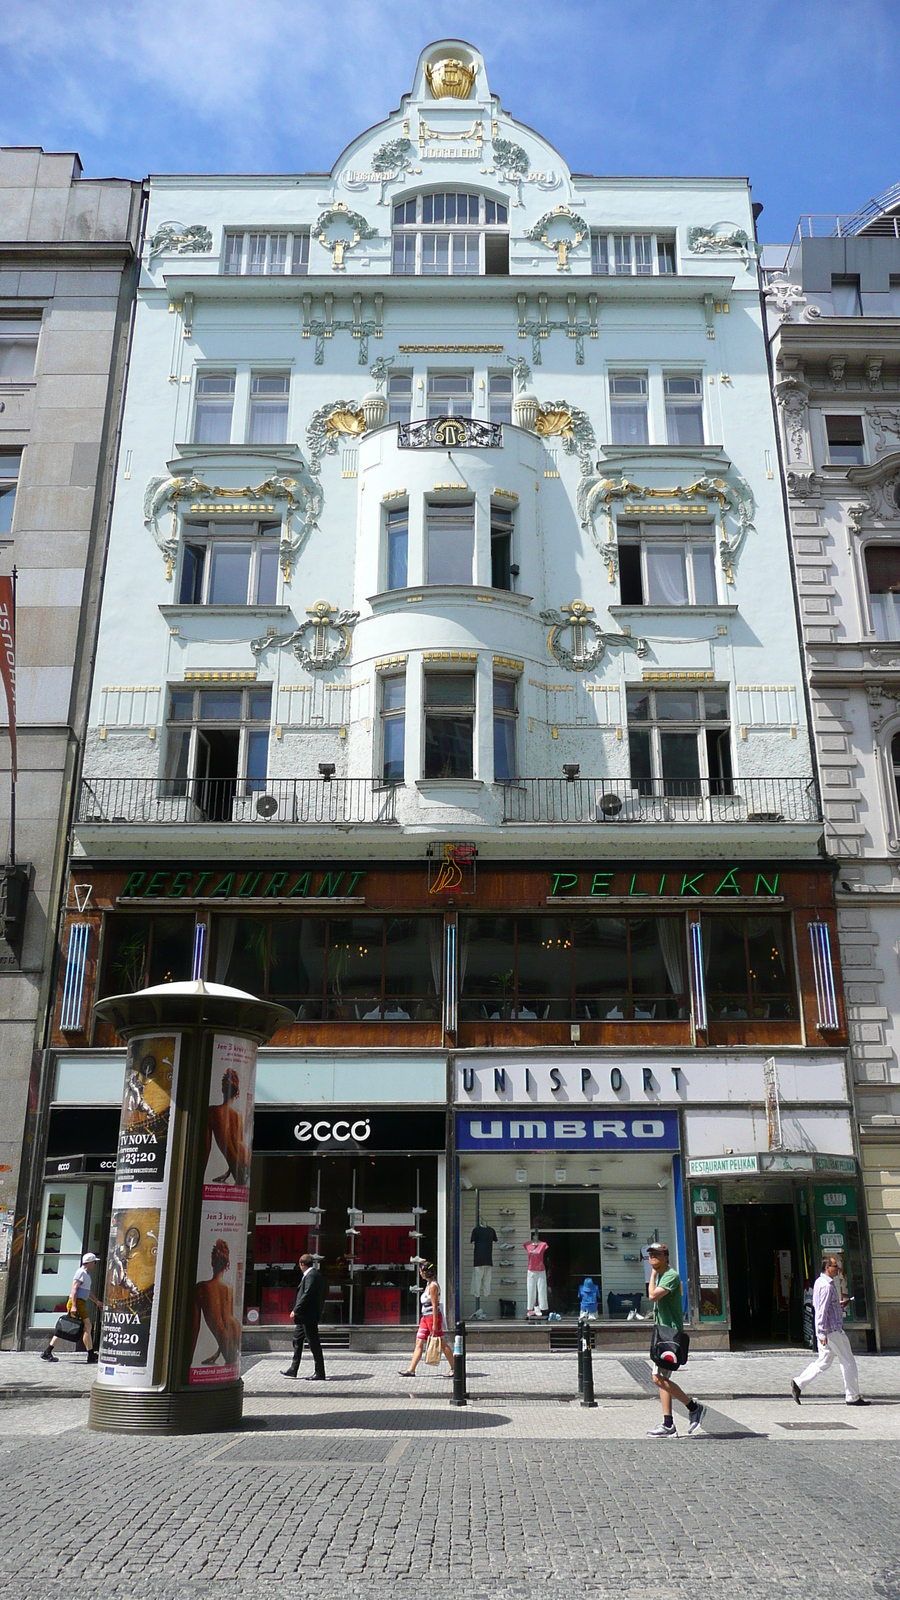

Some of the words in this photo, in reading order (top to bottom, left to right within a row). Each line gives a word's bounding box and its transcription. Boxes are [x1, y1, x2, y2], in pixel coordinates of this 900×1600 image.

[121, 870, 367, 898] RESTAURANT
[551, 867, 780, 897] PELIKÁN
[463, 1067, 682, 1092] UNISPORT
[294, 1118, 371, 1142] ecco
[469, 1120, 665, 1139] UMBRO
[129, 1134, 158, 1145] NOVA
[125, 1152, 156, 1164] 23:20
[690, 1160, 729, 1172] RESTAURANT
[729, 1157, 756, 1170] PELIKÁN
[100, 1161, 118, 1169] ecc
[366, 1302, 399, 1312] SALE
[113, 1312, 141, 1325] NOVA
[108, 1332, 139, 1345] 23:20
